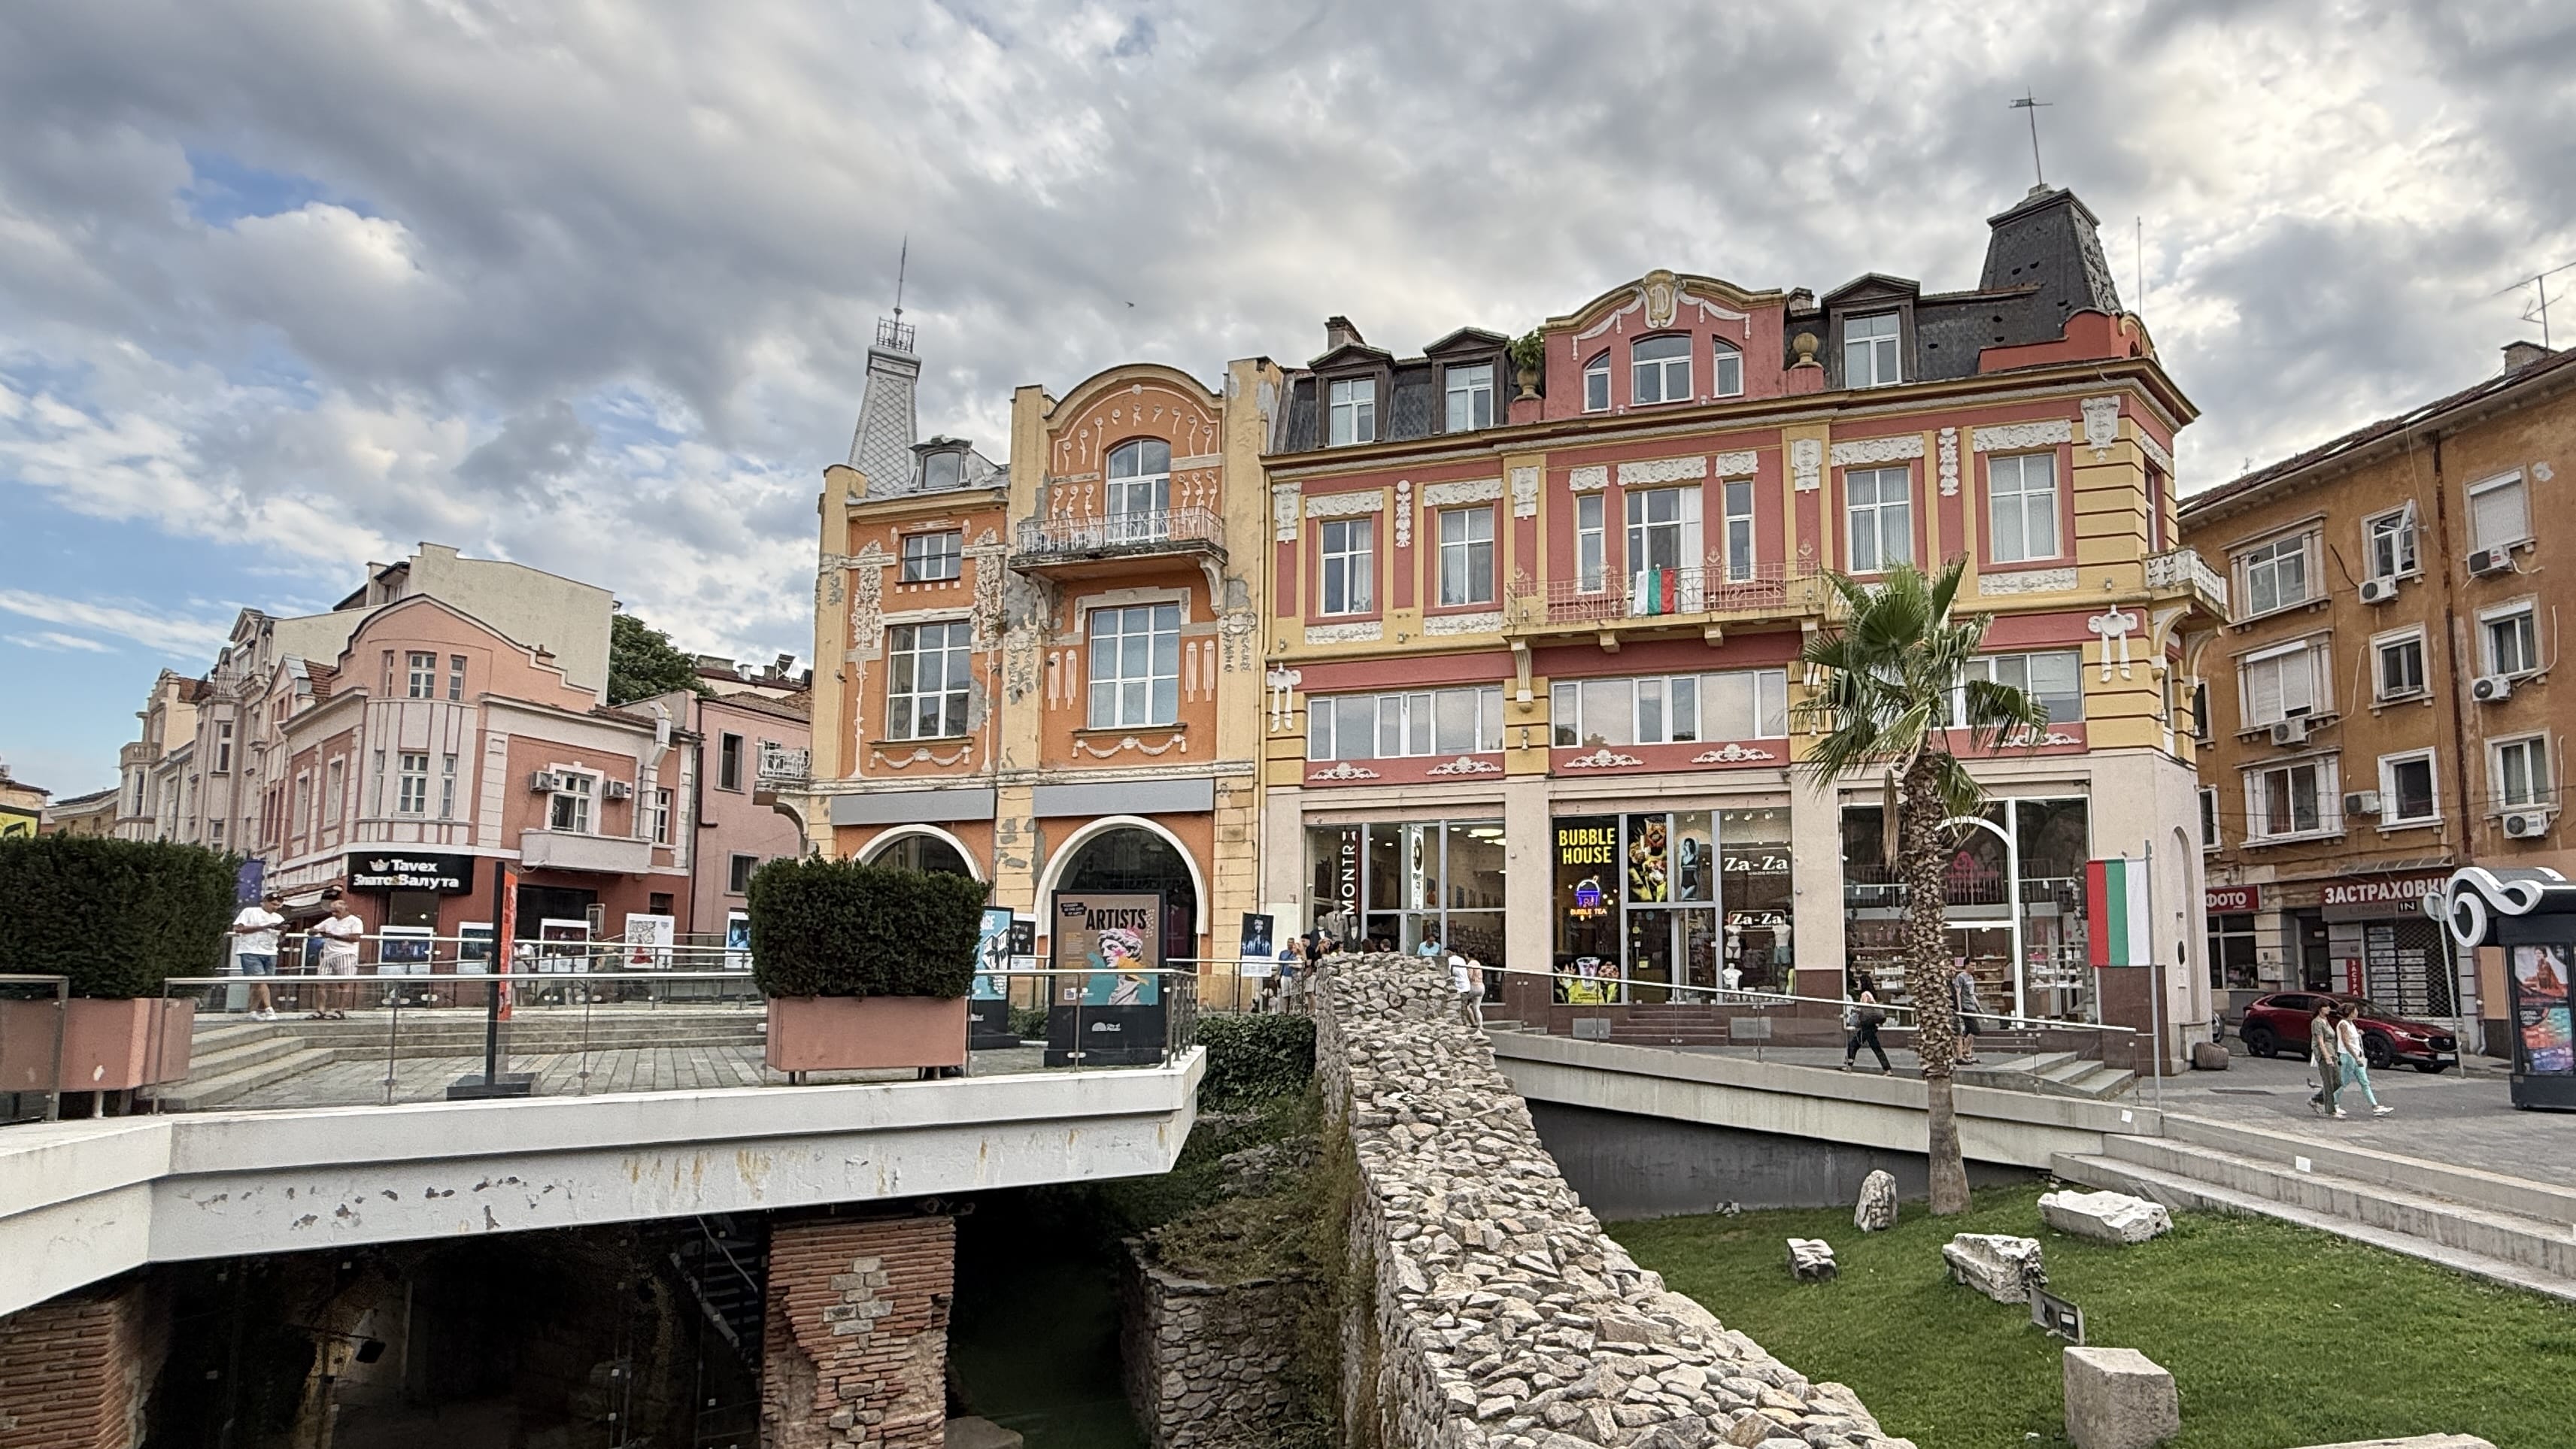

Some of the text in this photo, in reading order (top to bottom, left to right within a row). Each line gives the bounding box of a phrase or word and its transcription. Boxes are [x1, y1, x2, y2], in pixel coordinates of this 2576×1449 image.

[1558, 827, 1616, 847] BUBBLE
[1563, 846, 1613, 865] HOUSE
[390, 859, 438, 872] Tavex
[2205, 892, 2247, 908] ФОТО
[2399, 902, 2415, 912] IN
[1085, 908, 1147, 931] ARTISTS
